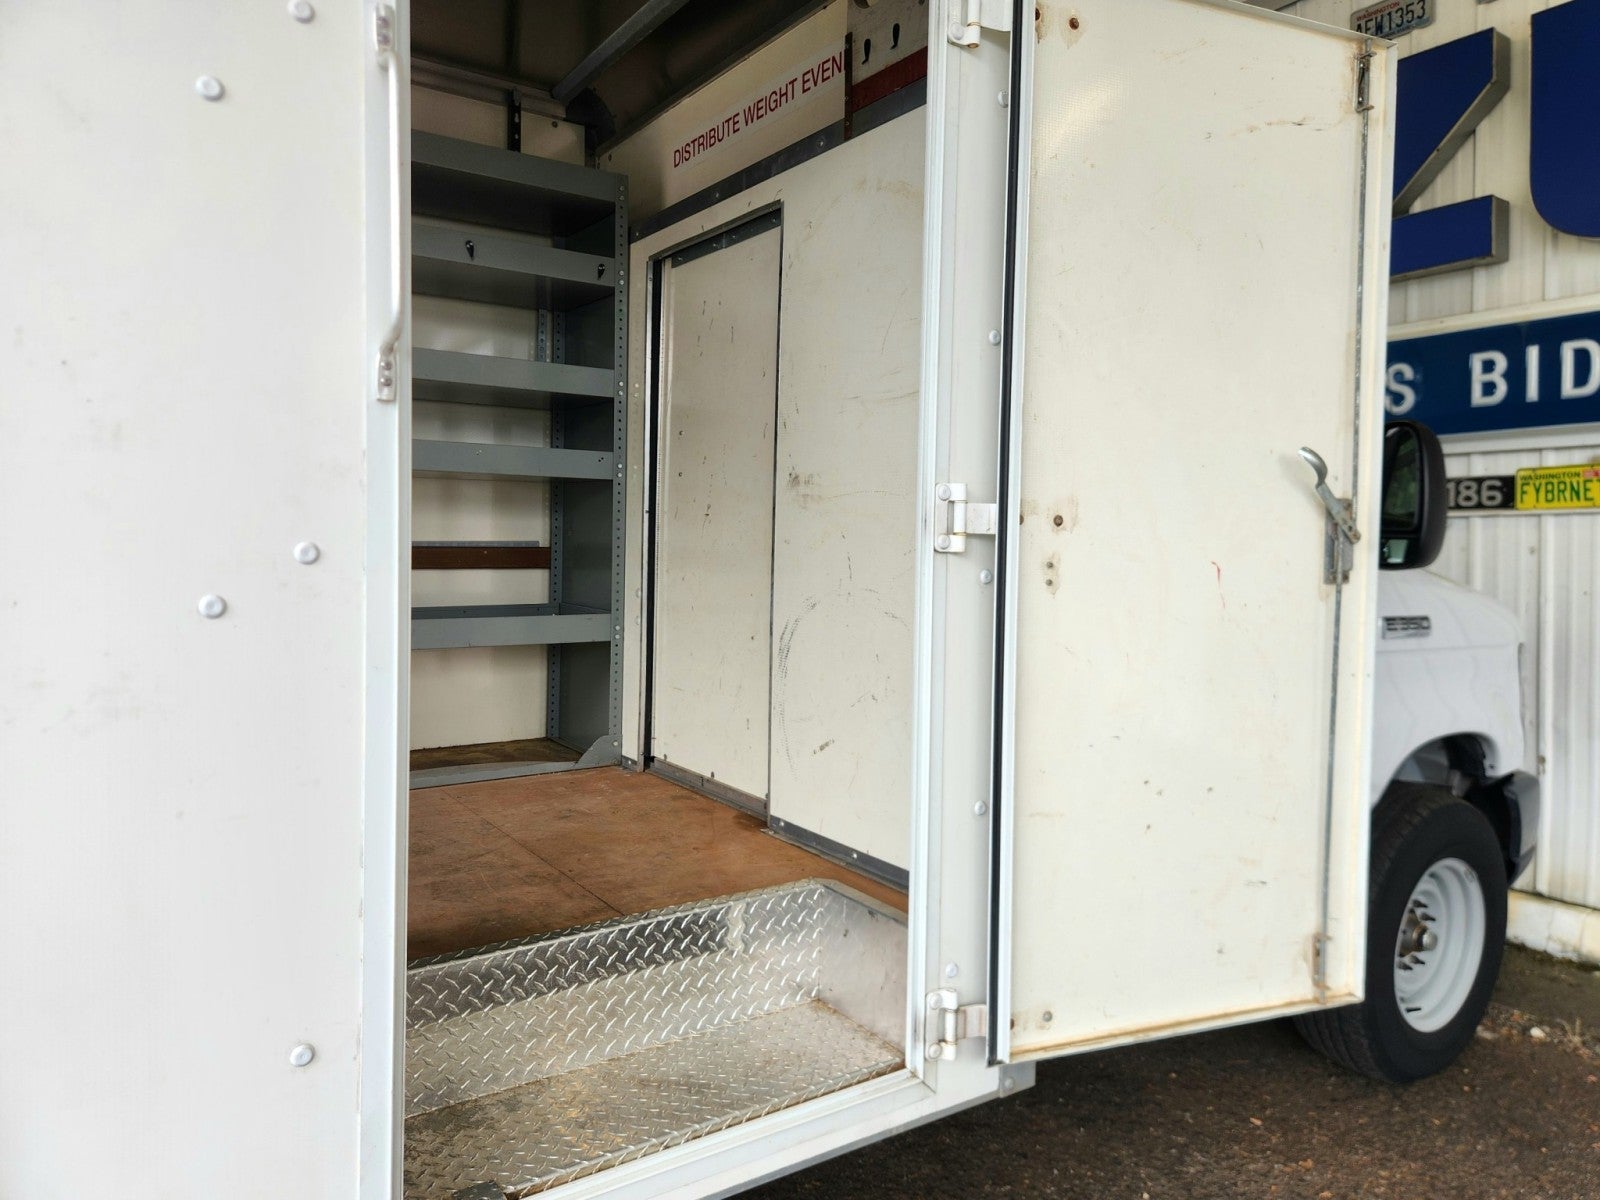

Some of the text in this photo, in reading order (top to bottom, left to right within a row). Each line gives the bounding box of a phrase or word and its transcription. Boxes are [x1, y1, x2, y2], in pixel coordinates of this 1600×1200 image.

[1356, 1, 1401, 22] WASHINGTON
[673, 112, 741, 168] DISTRIBUTE
[744, 78, 798, 127] WEIGHT
[1519, 470, 1581, 482] WASHINGTON
